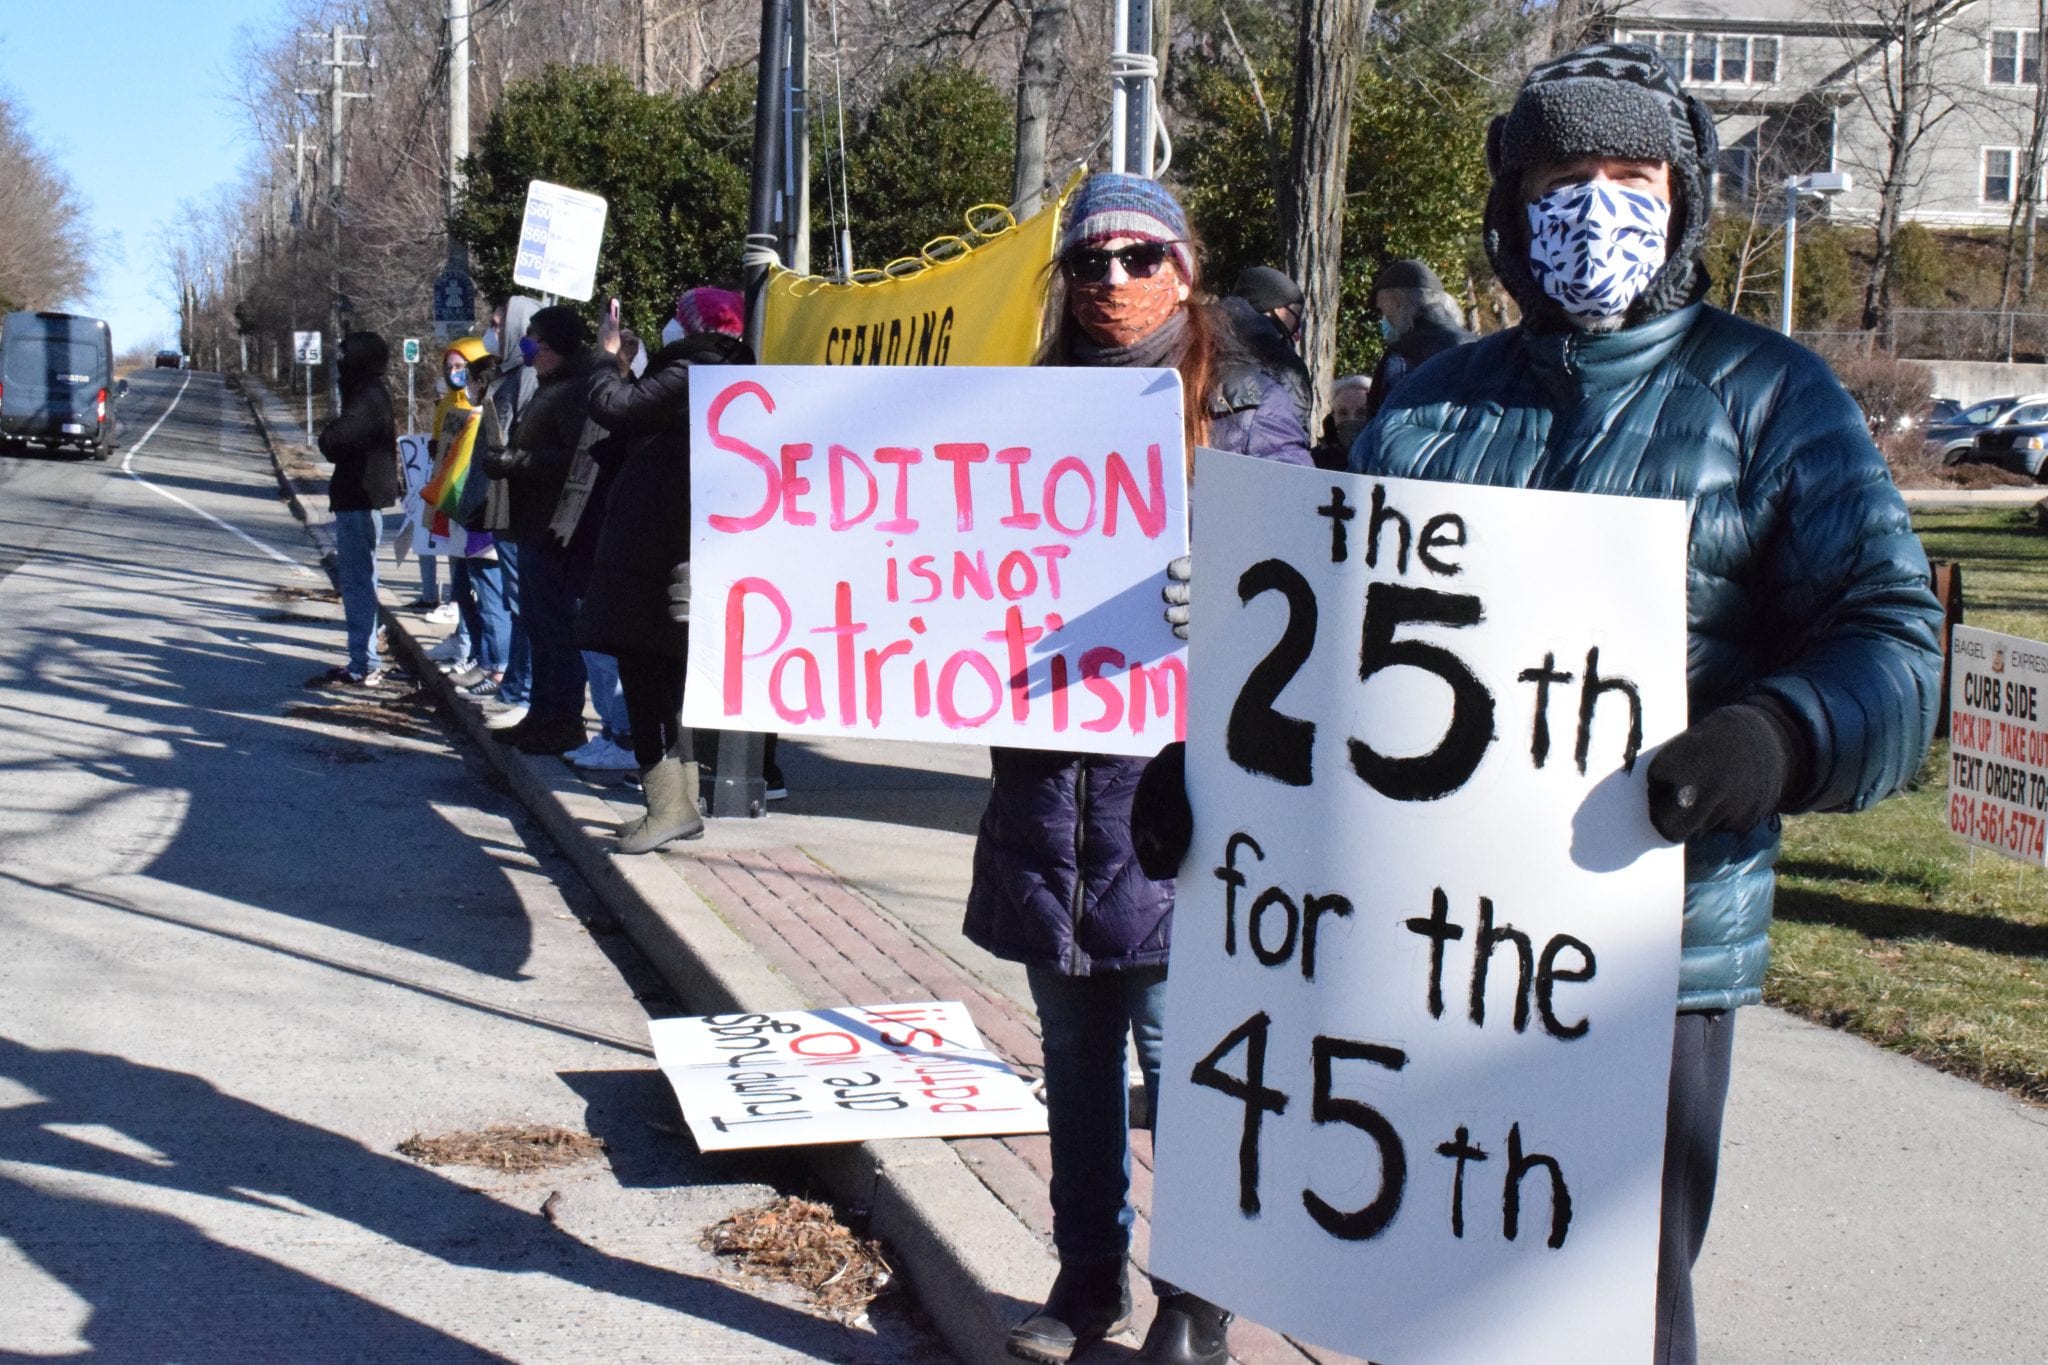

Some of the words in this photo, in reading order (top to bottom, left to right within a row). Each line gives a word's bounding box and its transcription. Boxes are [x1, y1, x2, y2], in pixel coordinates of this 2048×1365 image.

[524, 227, 548, 245] S69
[529, 201, 553, 220] S60
[519, 252, 543, 270] S76
[298, 348, 319, 361] 35
[707, 380, 1168, 539] SEDITION
[1317, 484, 1467, 575] the
[886, 540, 942, 603] is
[953, 544, 1070, 600] NOT
[723, 577, 1187, 743] Patriotism
[1226, 558, 1643, 802] 25th
[1954, 639, 1986, 660] BAGEL
[1964, 671, 2001, 713] CURB
[2005, 680, 2038, 722] SIDE
[1952, 711, 1976, 749] PICK
[1978, 717, 1992, 752] UP
[2000, 722, 2027, 763] TAKE
[1952, 752, 1983, 792] TEXT
[1985, 761, 2027, 806] ORDER
[2030, 773, 2048, 813] TO:
[1951, 792, 2046, 859] 631-561-5774
[1214, 831, 1355, 983] for
[1405, 886, 1597, 1040] the
[789, 1031, 871, 1066] NO
[711, 1072, 813, 1133] Trump
[823, 1071, 909, 1111] are
[1190, 1010, 1573, 1249] 45th
